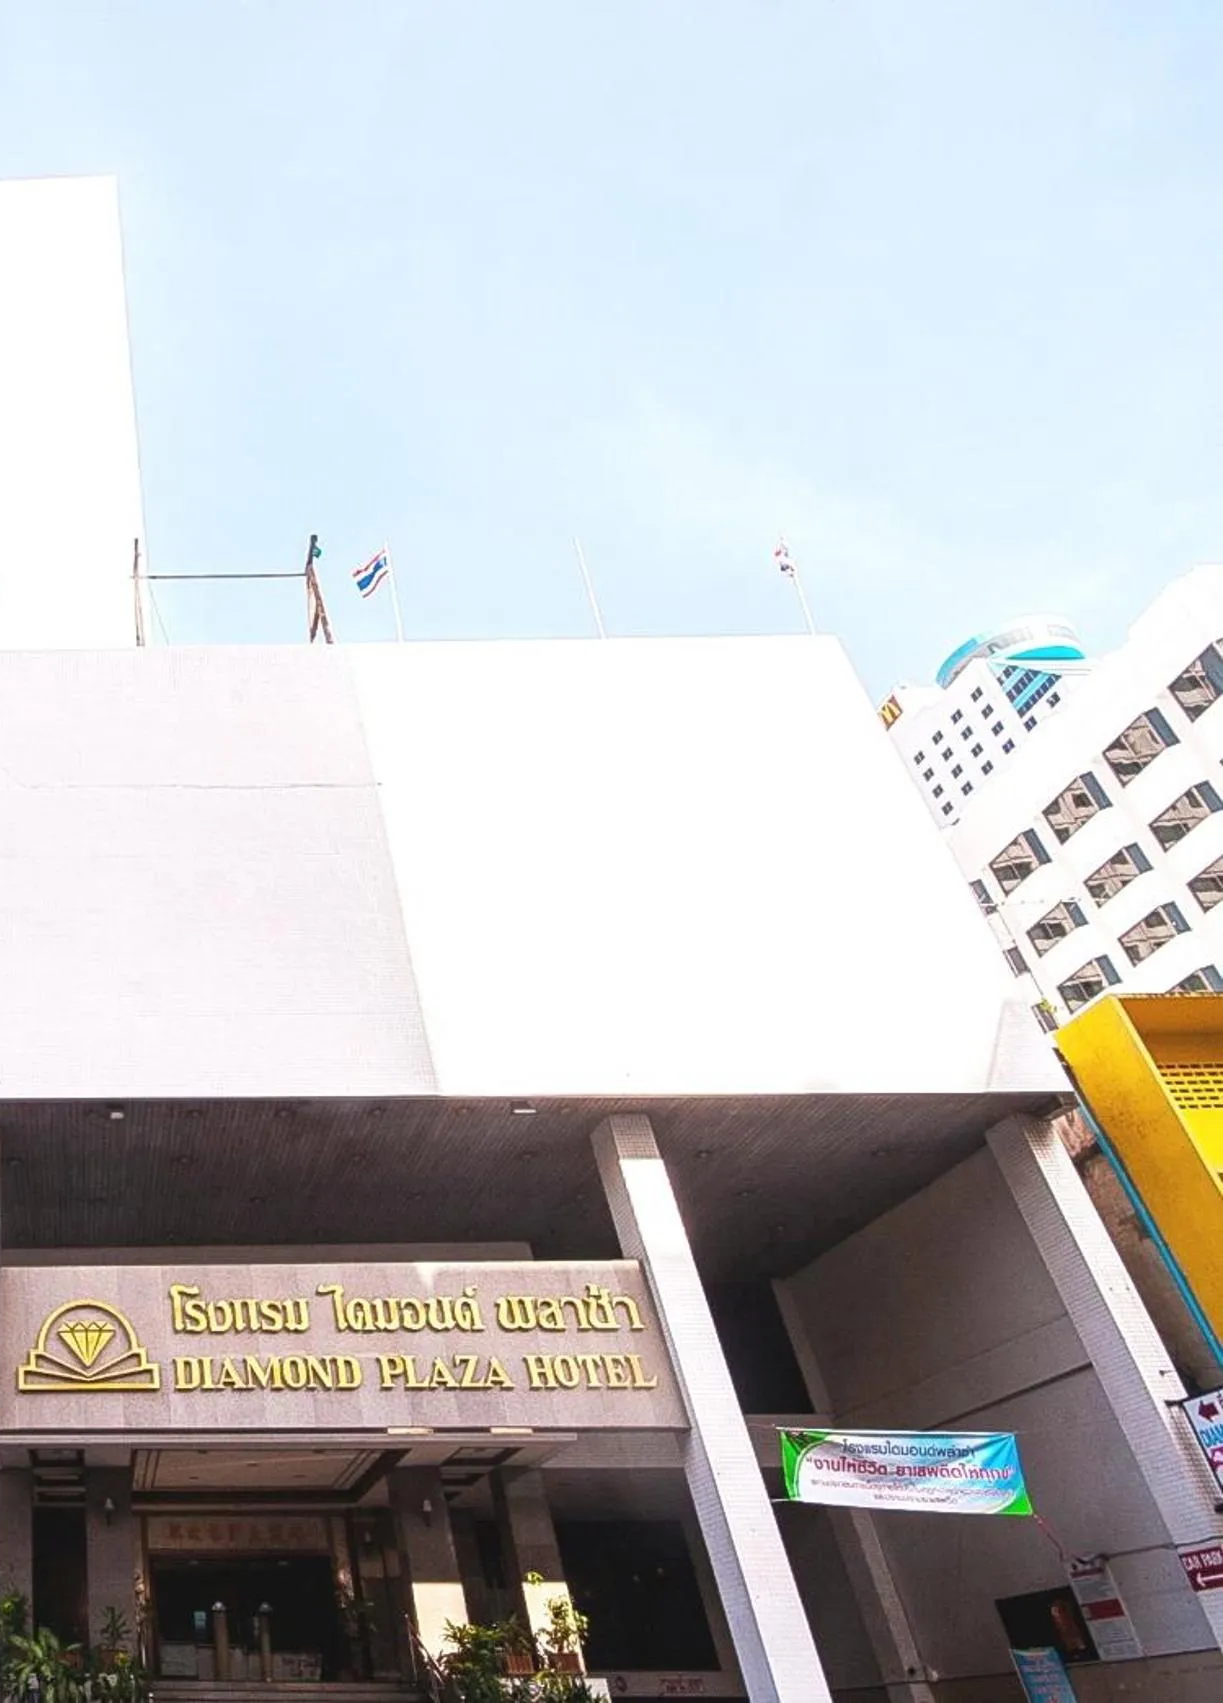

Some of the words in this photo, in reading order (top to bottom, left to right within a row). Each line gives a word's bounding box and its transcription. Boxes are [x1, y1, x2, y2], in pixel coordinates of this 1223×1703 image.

[169, 1284, 310, 1333] โรงแรม
[316, 1283, 484, 1332] ไดมอนด์
[495, 1283, 645, 1332] พลาซ่า
[173, 1355, 362, 1391] DIAMOND
[376, 1354, 515, 1390] PLAZA
[524, 1353, 659, 1389] HOTEL
[1182, 1555, 1203, 1571] CAR
